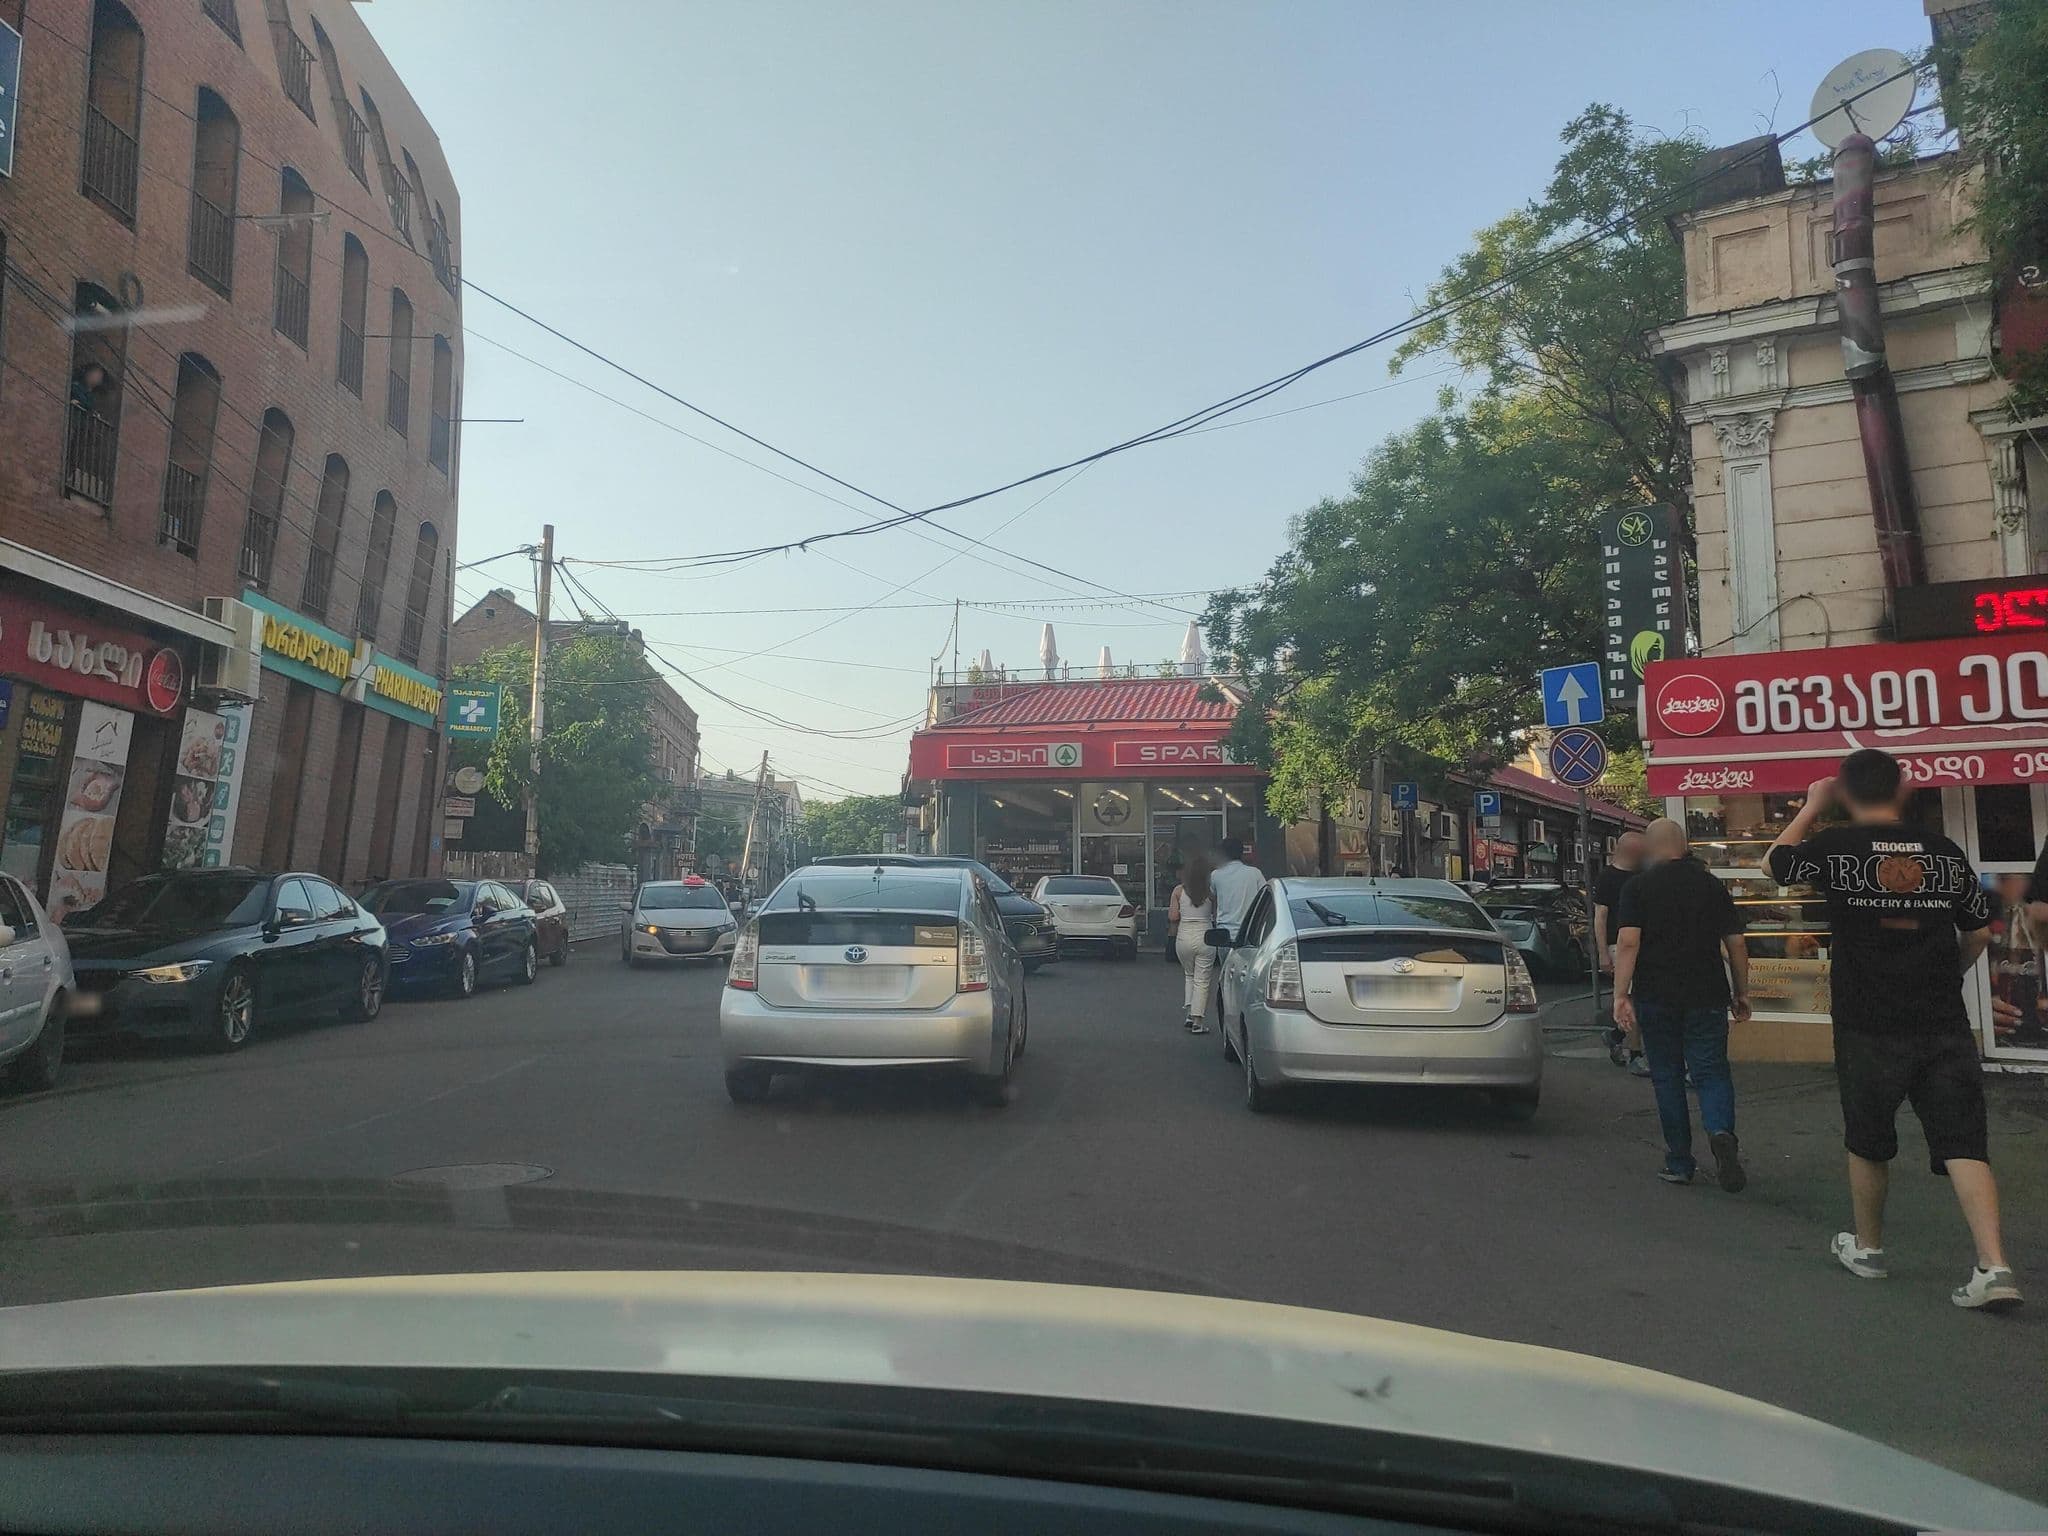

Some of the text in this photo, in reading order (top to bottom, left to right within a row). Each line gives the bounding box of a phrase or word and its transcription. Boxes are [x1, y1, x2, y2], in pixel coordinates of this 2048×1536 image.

[1652, 539, 1671, 631] სალონი
[1603, 545, 1627, 699] სილამაზის
[28, 620, 143, 689] სახლი
[262, 615, 349, 679] არმადეპო
[374, 665, 443, 716] PHARMADEPOT
[1735, 668, 1940, 734] მწვადი
[449, 724, 493, 733] PHARMADEPOT
[1140, 745, 1221, 761] SPAR
[1896, 755, 1985, 782] ვადი
[1399, 785, 1409, 800] P
[1480, 795, 1493, 813] P
[1872, 841, 1924, 852] KROGER
[1847, 897, 1952, 909] GROCERY & BAKING
